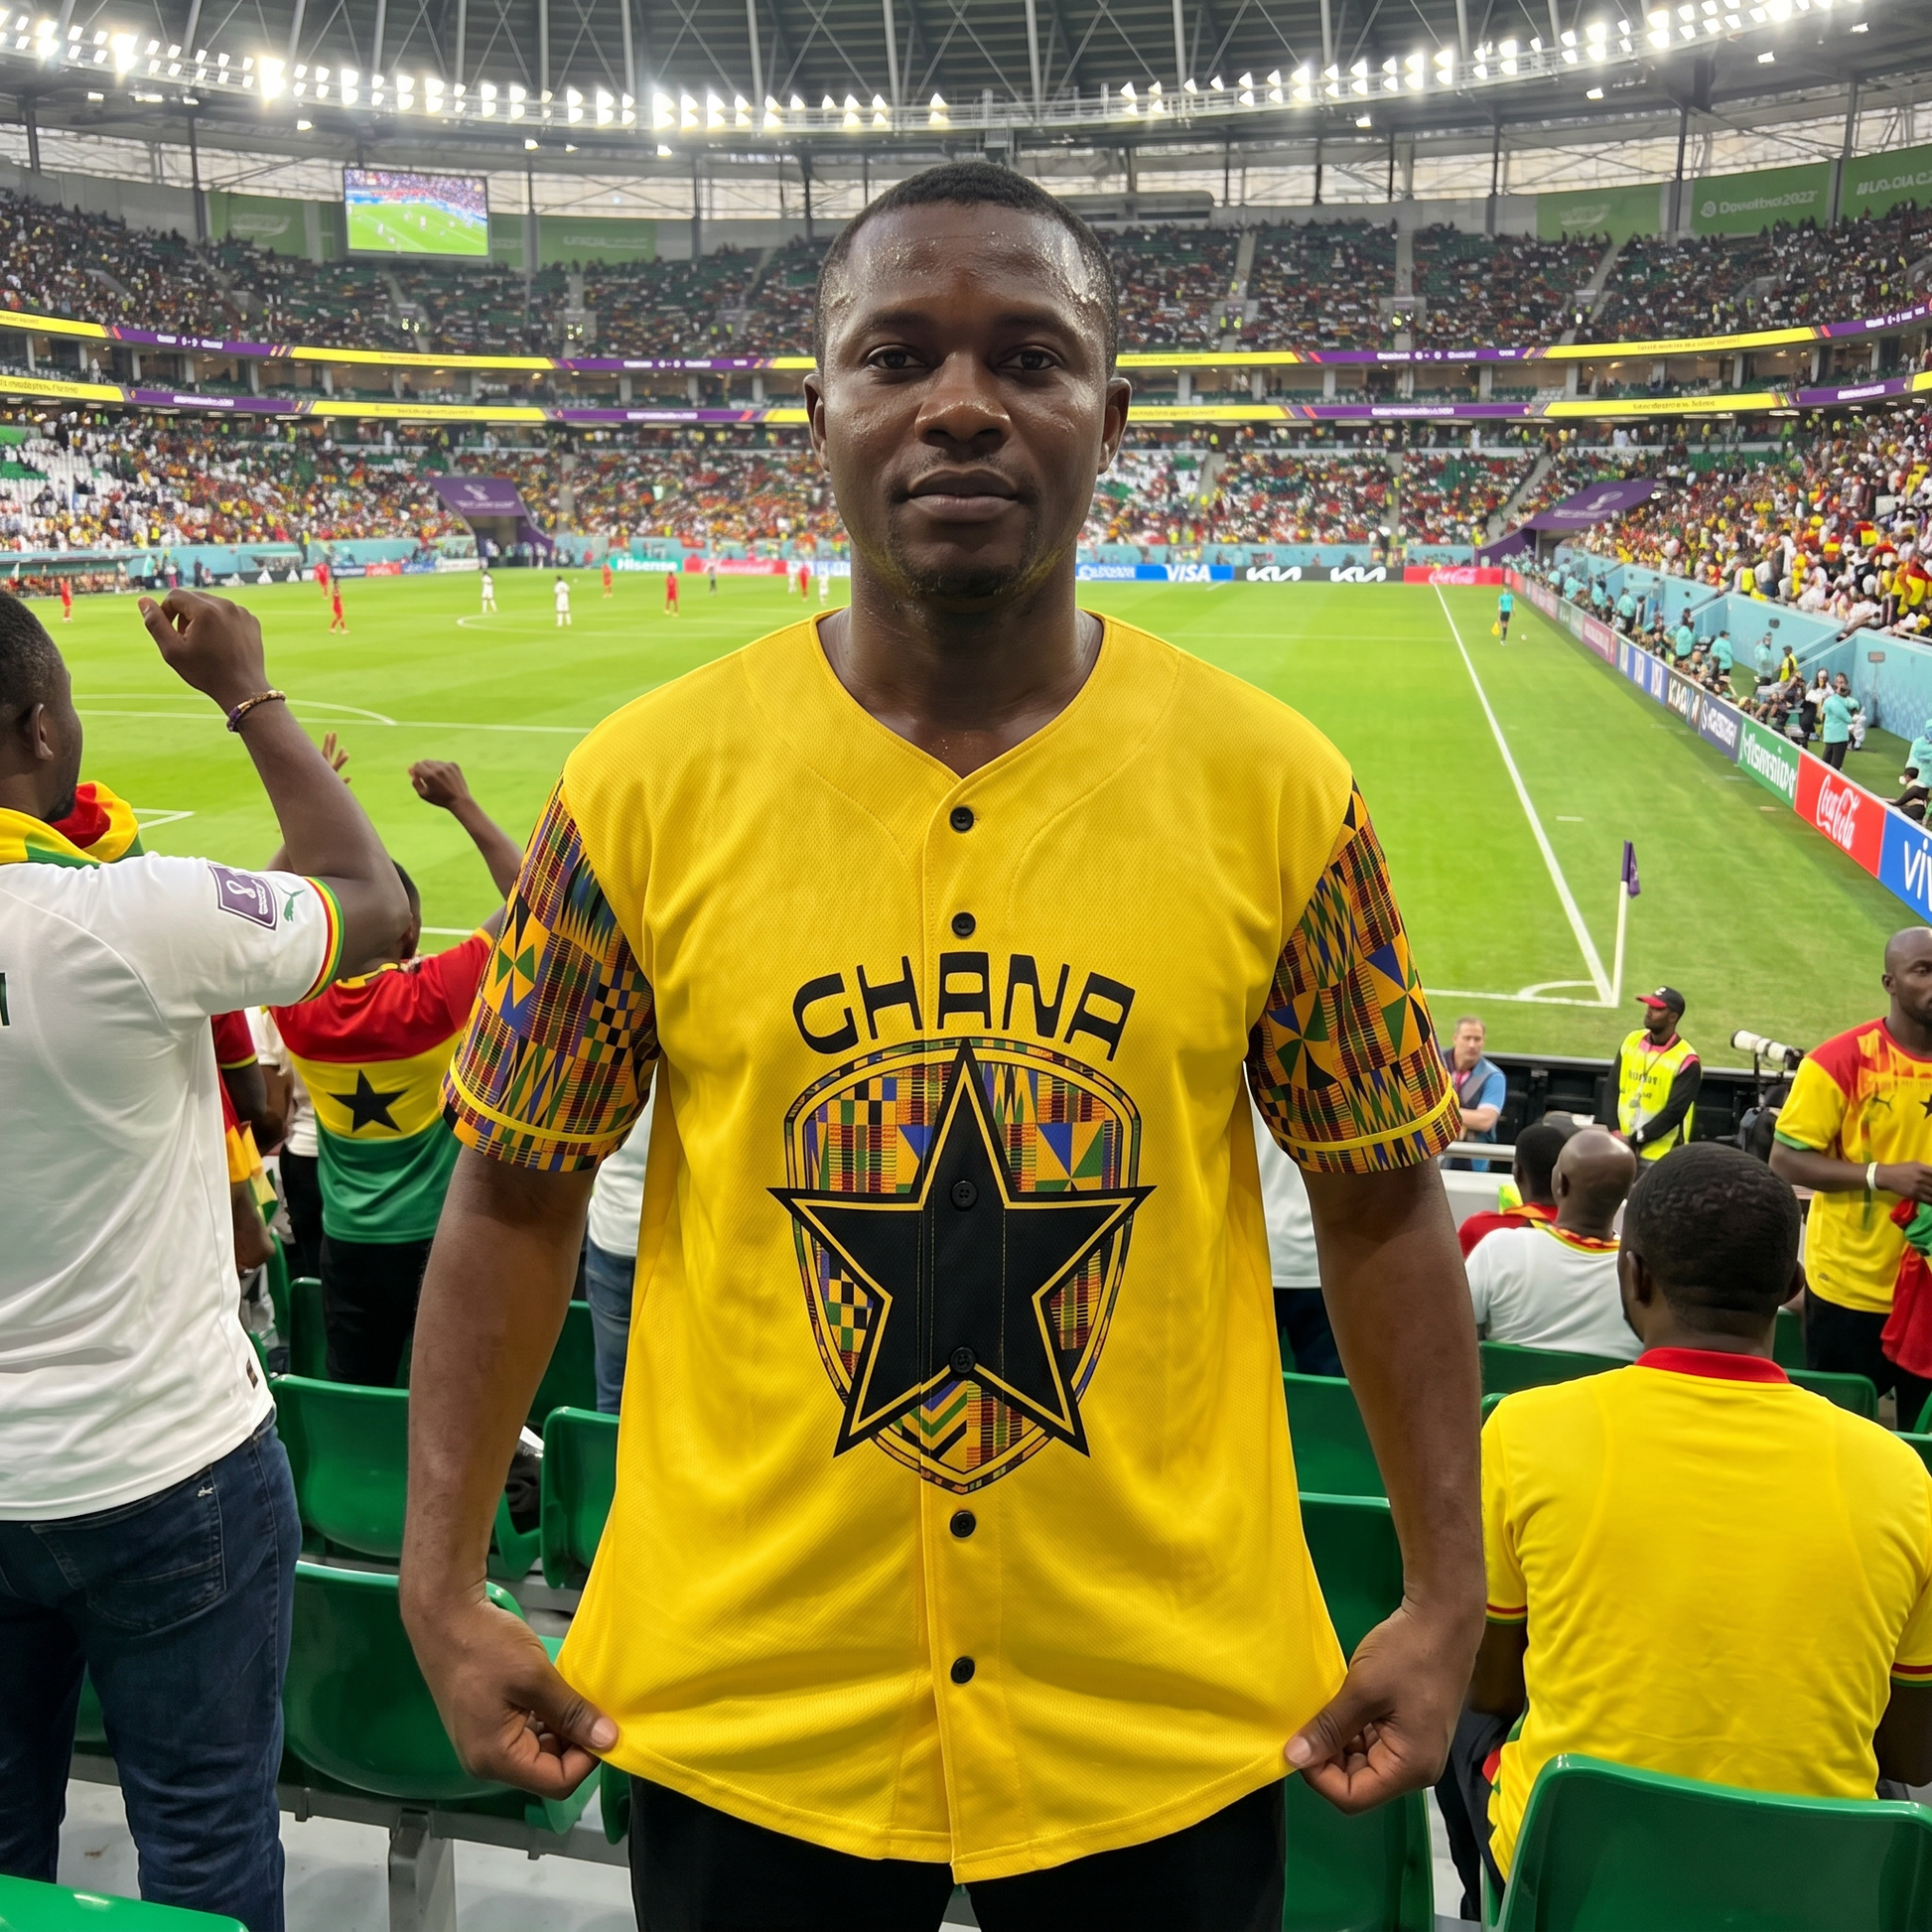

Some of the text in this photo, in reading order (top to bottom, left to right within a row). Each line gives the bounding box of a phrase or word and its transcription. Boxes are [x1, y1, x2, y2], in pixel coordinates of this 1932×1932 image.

[617, 558, 678, 572] Hisense
[1163, 564, 1212, 582] VISA
[791, 951, 1136, 1062] GHANA
